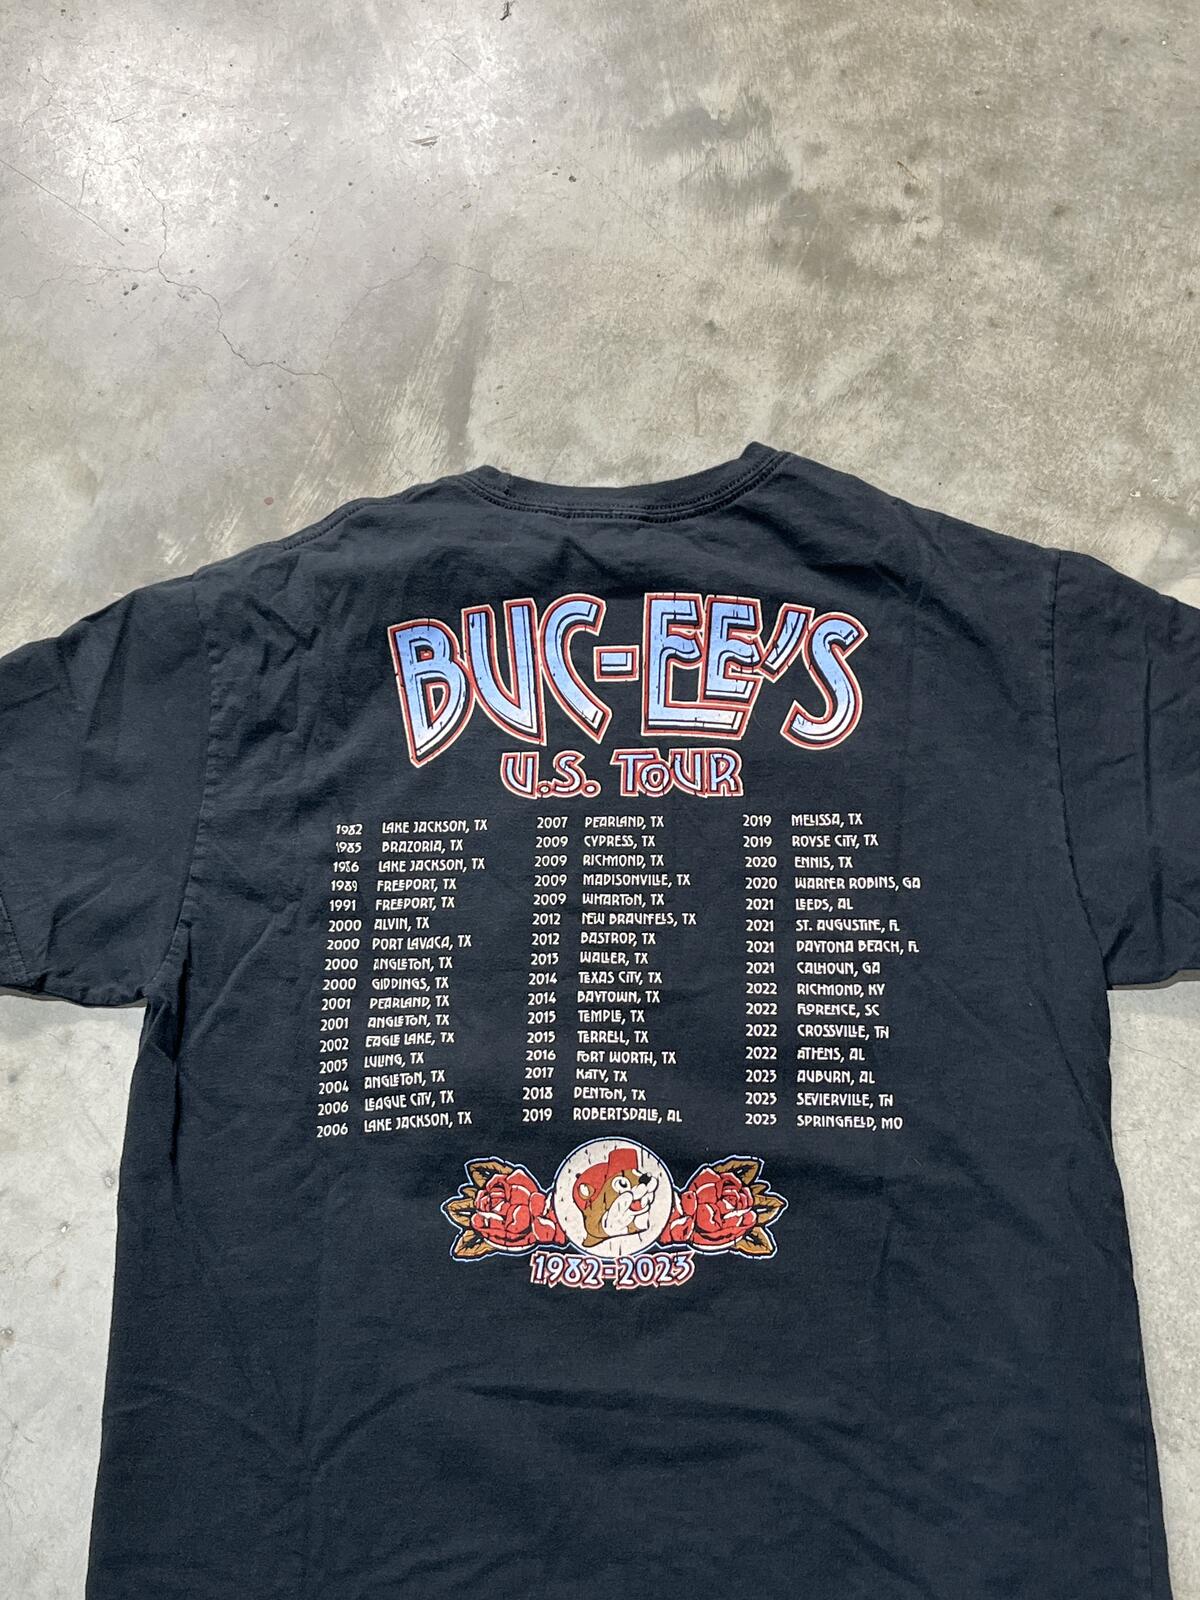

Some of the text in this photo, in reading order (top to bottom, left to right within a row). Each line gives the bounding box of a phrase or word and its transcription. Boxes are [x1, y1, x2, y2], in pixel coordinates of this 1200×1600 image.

[387, 592, 869, 768] BUC-EE'S
[500, 747, 744, 798] U.S. TOUR
[336, 819, 488, 836] 1982 LAKE JACKSON, TX
[537, 815, 664, 830] 2007 PEARLAND, TX
[742, 813, 863, 828] 2019 MELISSA, TX
[535, 834, 656, 850] 2009 CYPRESS, TX
[743, 834, 879, 849] 2019 ROYSE CITY, TX
[333, 857, 485, 873] 1986 LAKE JACKSON, TX
[534, 854, 664, 869] 2009 RICHMOND, TX
[744, 856, 853, 871] 2020 ENNIS, TX
[331, 878, 457, 893] 1989 FREEPORT, TX
[534, 873, 691, 888] 2009 MADISONVILLE, TX
[745, 876, 921, 892] 2020 WARNER ROBINS, GA
[329, 896, 455, 912] 1991 FREEPORT, TX
[533, 893, 665, 908] 2009 WHARTON, TX
[745, 897, 854, 913] 2021 LEEDS, AL
[328, 916, 430, 933] 2000 ALVIN, TX
[532, 912, 697, 927] 2012 NEW BRAUNFELS, TX
[745, 918, 900, 934] 2021 ST. AUGUSTINE, FL
[326, 934, 472, 951] 2000 PORT LAVACA, TX
[531, 931, 656, 947] 2012 BASTROP, TX
[746, 939, 920, 956] 2021 DAYTONA BEACH, FL
[324, 956, 453, 972] 2000 ANGLETON, TX
[580, 951, 630, 967] WALLER,
[634, 952, 649, 964] TX
[746, 961, 881, 978] 2021 CALHOUN, GA
[322, 976, 449, 992] 2000 GIDDINGS, TX
[528, 971, 663, 986] 2014 TEXAS CITY, TX
[527, 990, 660, 1006] 2014 BAYTOWN, TX
[746, 982, 885, 998] 2022 RICHMOND, KY
[321, 994, 450, 1011] 2001 PEARLAND, TX
[745, 1002, 880, 1019] 2022 FLORENCE, SC
[320, 1014, 450, 1032] 2001 ANGLETON, TX
[527, 1009, 645, 1025] 2015 TEMPLE, TX
[526, 1030, 649, 1046] 2015 TERRELL, TX
[745, 1023, 889, 1041] 2022 CROSSVILLE, TN
[319, 1031, 455, 1053] 2002 EAGLE LAKE, TX
[364, 1053, 406, 1069] LULING,
[410, 1051, 424, 1064] TX
[525, 1049, 677, 1067] 2016 FORT WORTH, TX
[745, 1046, 865, 1063] 2022 ATHENS, AL
[318, 1069, 445, 1095] 2004 ANGLETON, TX
[524, 1066, 628, 1083] 2017 KATY, TX
[797, 1069, 855, 1086] AUBURN,
[859, 1070, 876, 1084] AL
[522, 1086, 646, 1102] 2018 DENTON, TX
[317, 1090, 454, 1116] 2006 LEAGUE CITY, TX
[522, 1107, 683, 1124] 2019 ROBERTSDALE, AL
[316, 1111, 472, 1138] 2006 LAKE JACKSON, TX
[531, 1251, 696, 1289] 1982-2023
